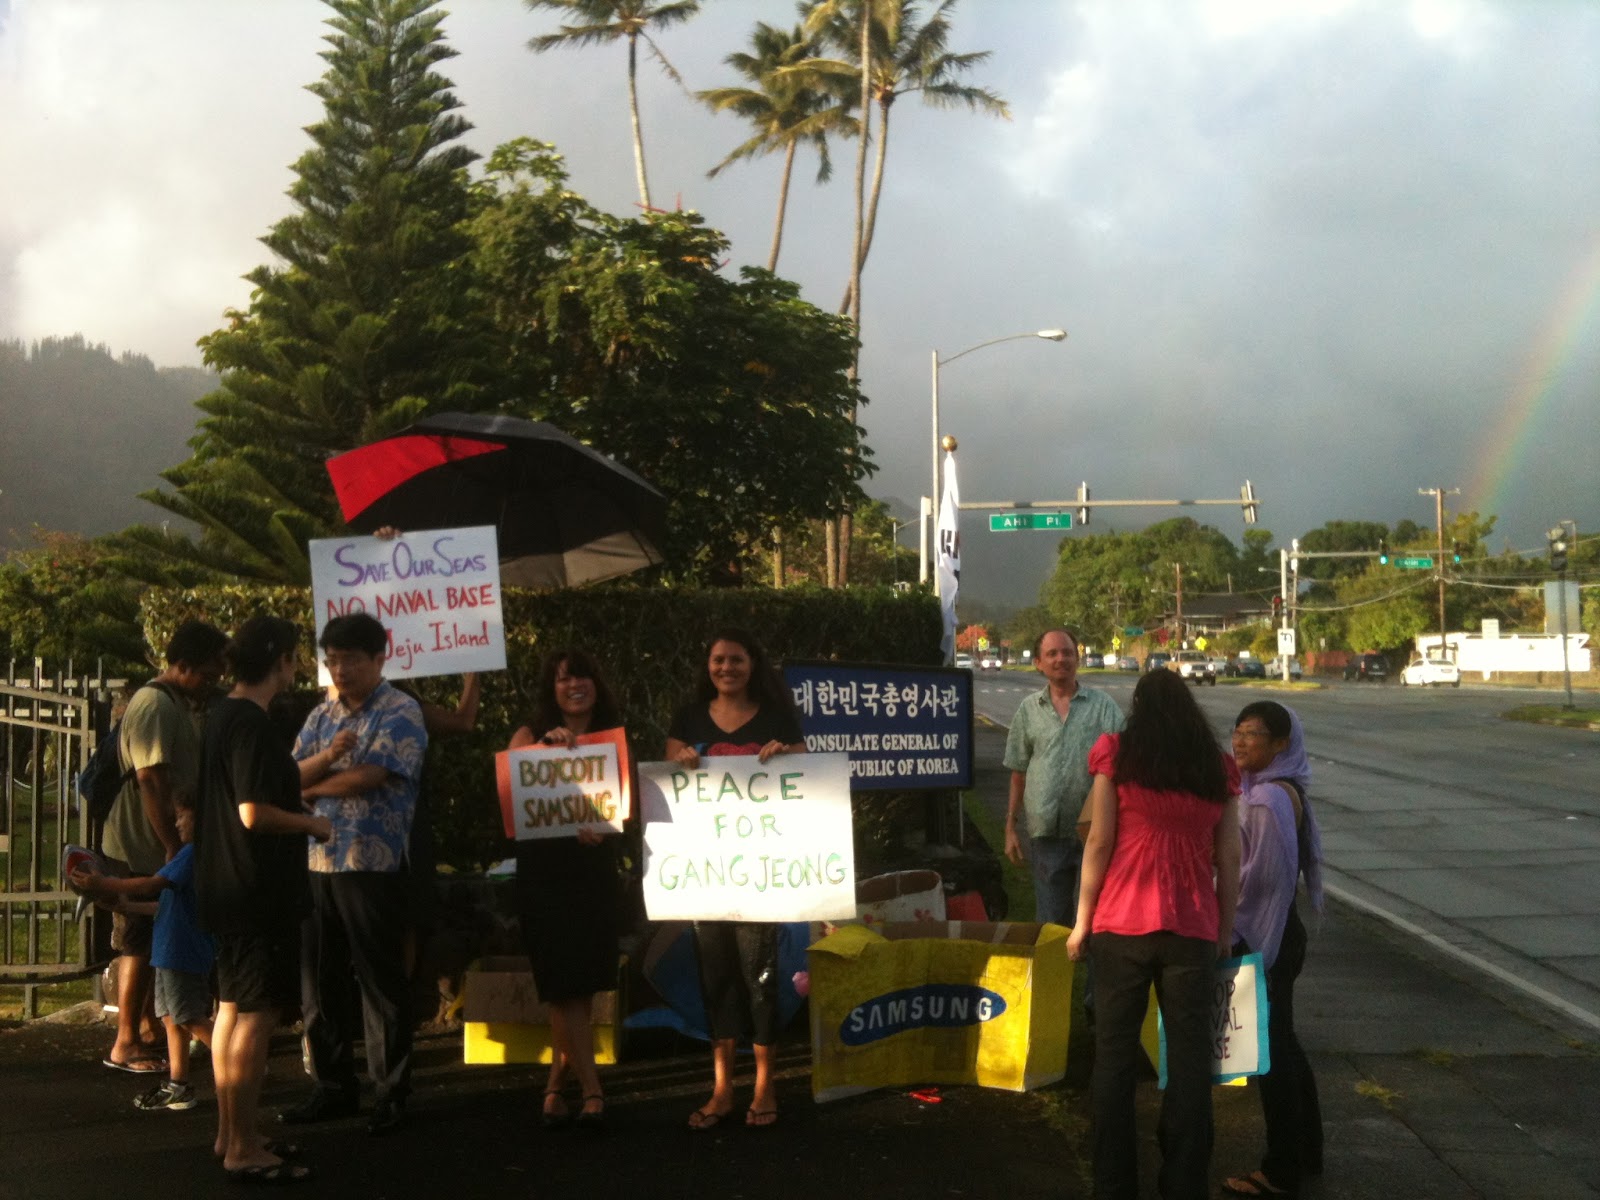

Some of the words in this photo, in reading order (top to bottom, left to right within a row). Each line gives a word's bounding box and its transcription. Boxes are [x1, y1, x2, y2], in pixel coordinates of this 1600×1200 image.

[334, 544, 391, 586] SAVE
[392, 541, 436, 579] OUR
[433, 537, 487, 577] SEAS
[376, 588, 439, 620] NAVAL
[446, 583, 495, 610] BASE
[385, 628, 424, 670] Jeju
[429, 620, 490, 651] Island
[804, 734, 879, 752] ONSULATE
[882, 734, 940, 751] GENERAL
[942, 734, 959, 749] OF
[519, 755, 608, 788] BOYCOTT
[849, 760, 895, 777] PUBLIC
[897, 759, 914, 776] OF
[917, 758, 959, 775] KOREA
[671, 771, 804, 803] PEACE
[523, 789, 617, 828] SAMSUNG
[714, 814, 782, 838] FOR
[1216, 980, 1236, 1006] OP
[850, 995, 992, 1033] SAMSUNG
[1212, 1007, 1243, 1032] VAL
[1214, 1036, 1231, 1060] SE
